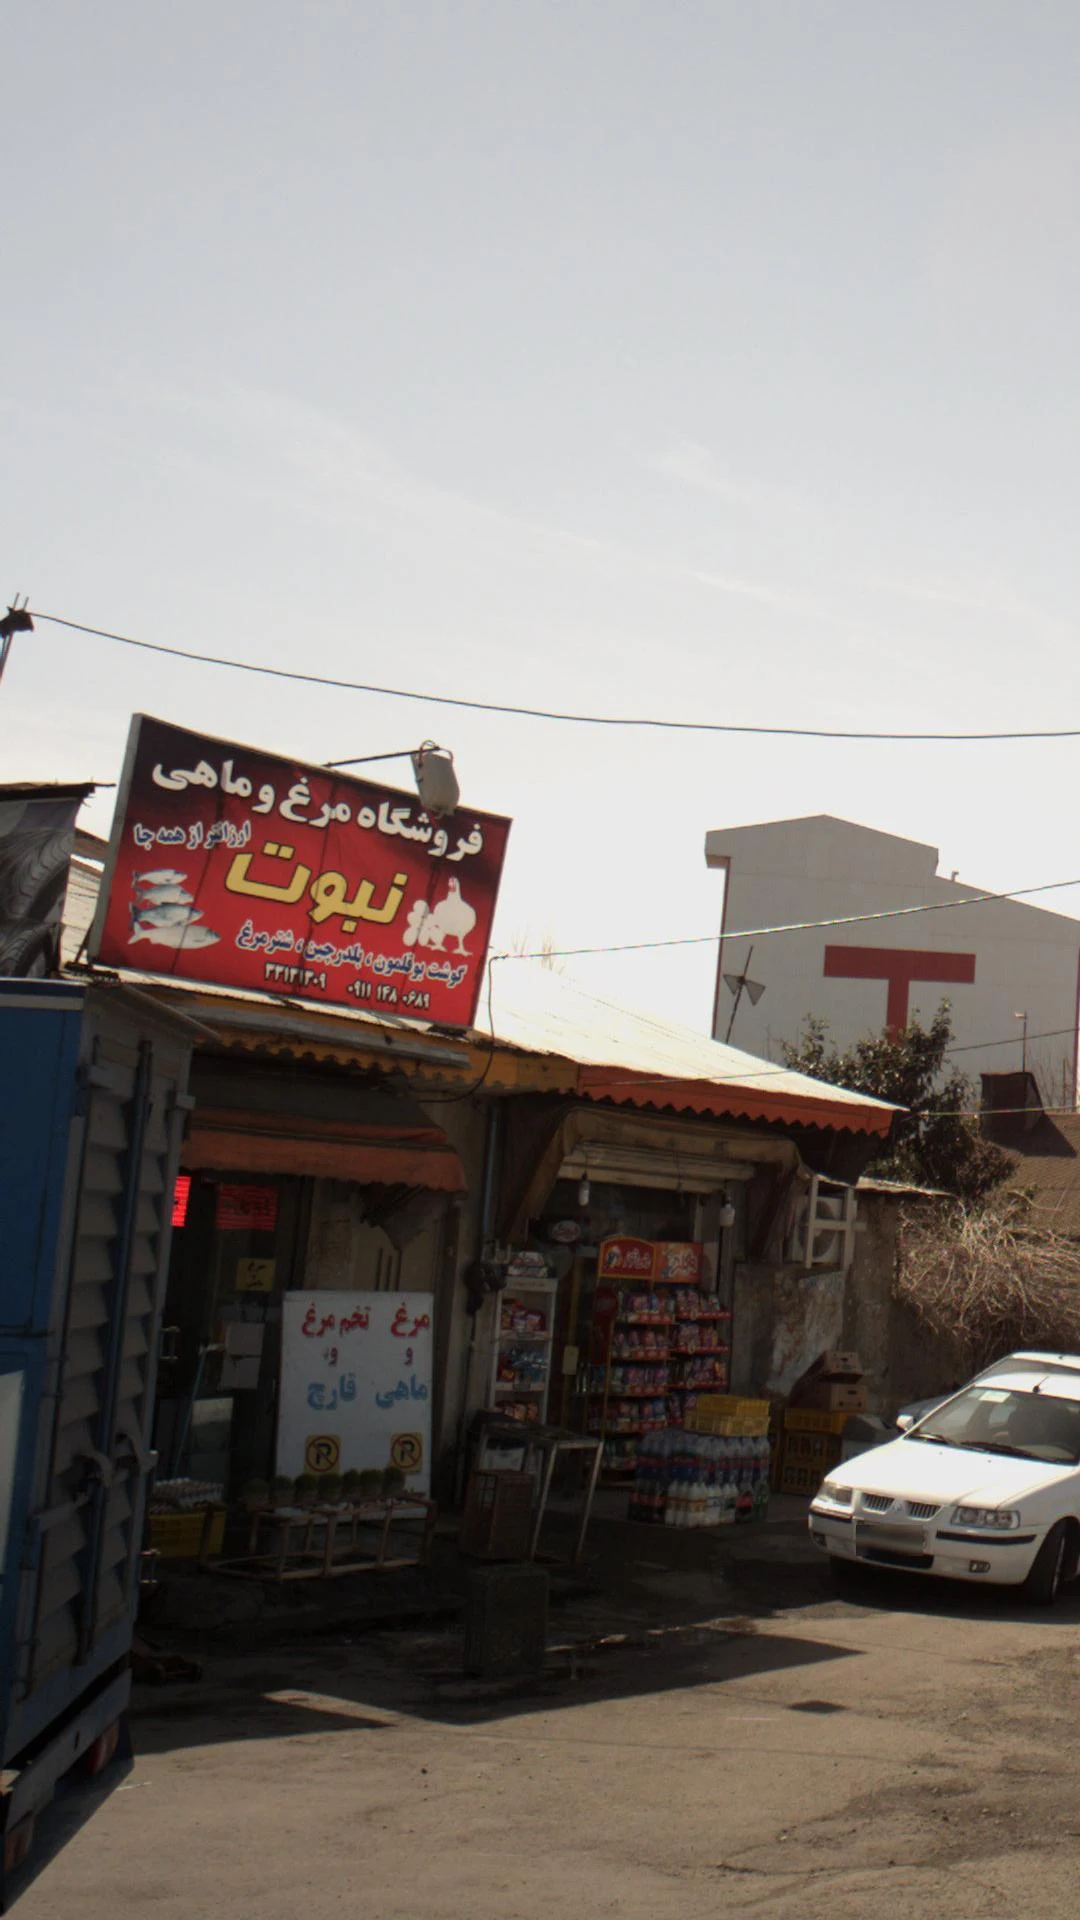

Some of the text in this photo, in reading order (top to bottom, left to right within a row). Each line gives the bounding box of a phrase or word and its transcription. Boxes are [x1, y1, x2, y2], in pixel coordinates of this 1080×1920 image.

[152, 759, 483, 862] فروشگاه مرغ و ماهی
[133, 822, 155, 850] جا
[156, 826, 186, 845] همه
[224, 842, 410, 934] نبوت
[427, 962, 469, 988] گوشت
[302, 1302, 371, 1338] تخم مرغ
[390, 1302, 430, 1338] مرغ
[404, 1347, 414, 1367] و
[307, 1372, 357, 1411] قارچ
[375, 1373, 429, 1409] ماهی
